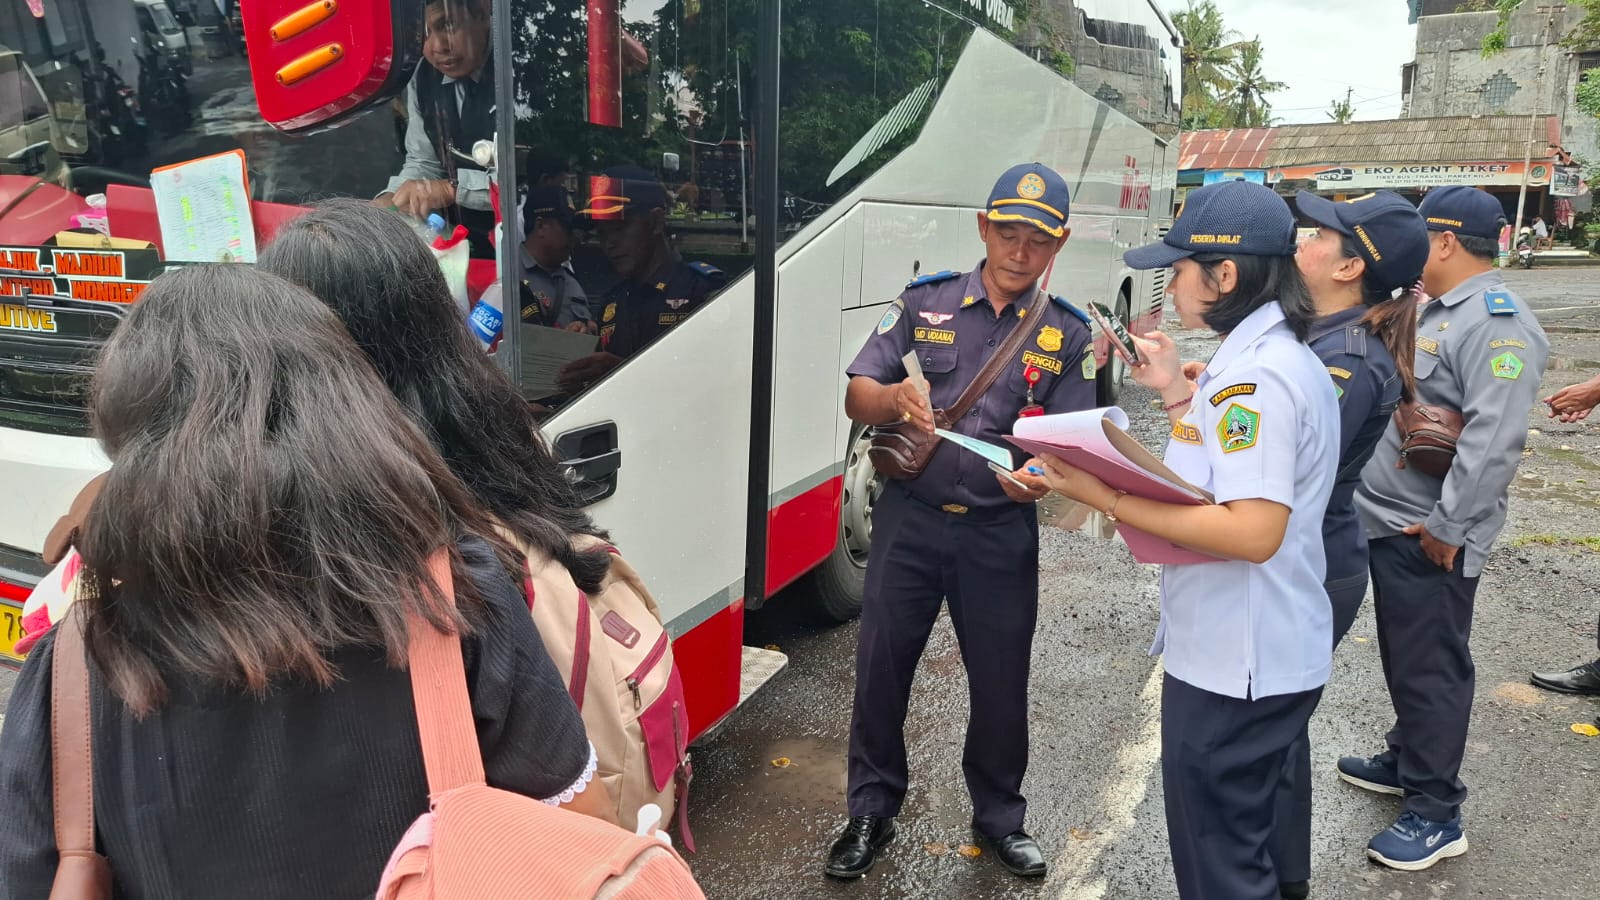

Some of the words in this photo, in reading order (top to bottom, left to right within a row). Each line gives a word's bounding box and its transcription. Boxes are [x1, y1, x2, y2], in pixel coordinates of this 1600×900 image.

[1457, 165, 1509, 173] TIKET
[1190, 234, 1216, 244] PESERTA
[1217, 234, 1241, 244] DIKLAT
[54, 252, 123, 277] MADIUN
[1023, 353, 1061, 371] PENGUJI
[1226, 384, 1253, 397] TABANAN
